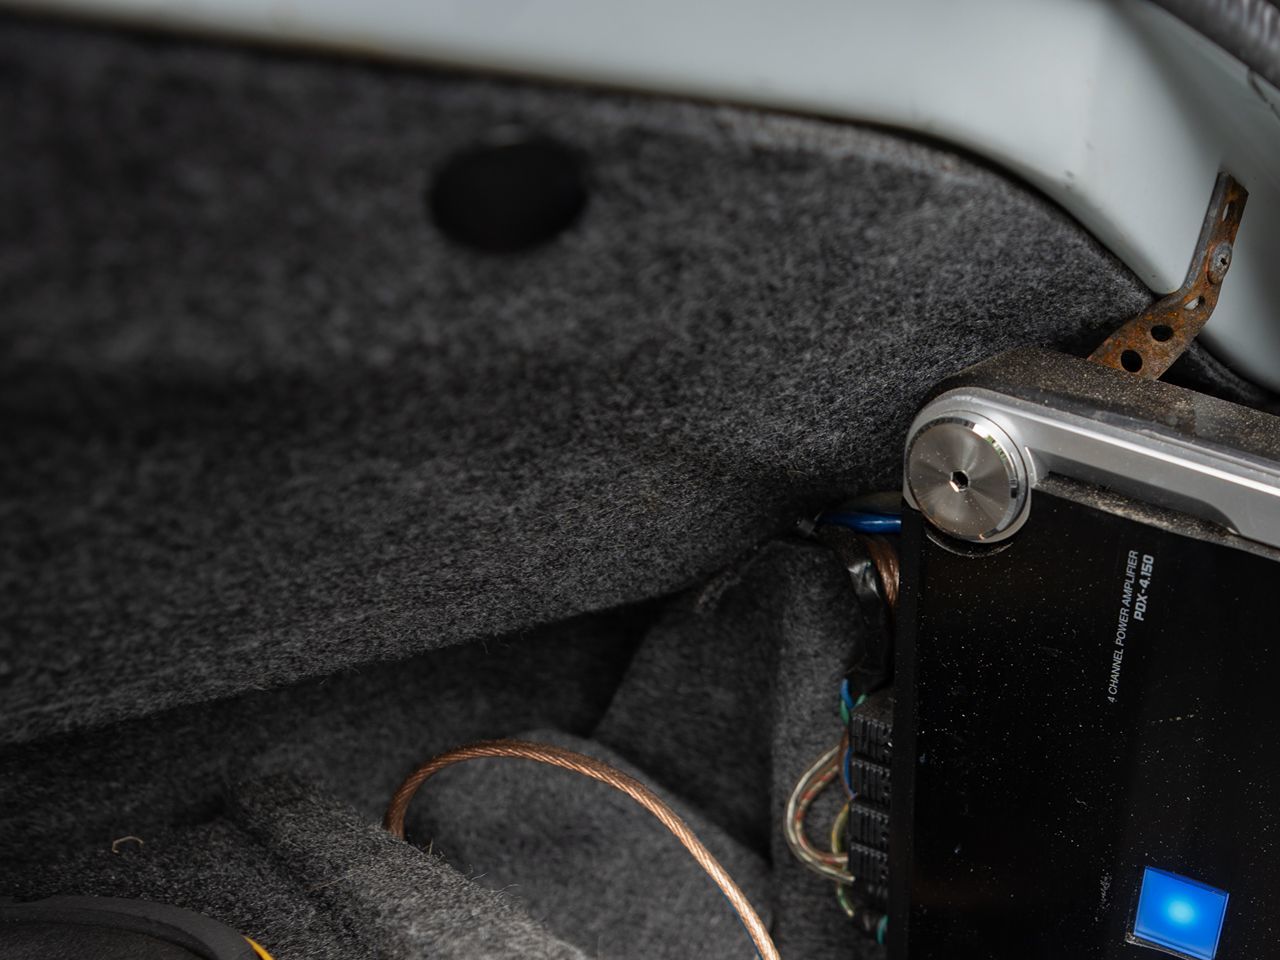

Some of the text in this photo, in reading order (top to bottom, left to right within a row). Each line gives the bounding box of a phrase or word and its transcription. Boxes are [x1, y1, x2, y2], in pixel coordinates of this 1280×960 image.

[1121, 550, 1139, 607] AMPLIFIER
[1133, 554, 1155, 621] PDX-4.150
[1115, 608, 1130, 647] POWER
[1108, 649, 1124, 695] CHANNEL
